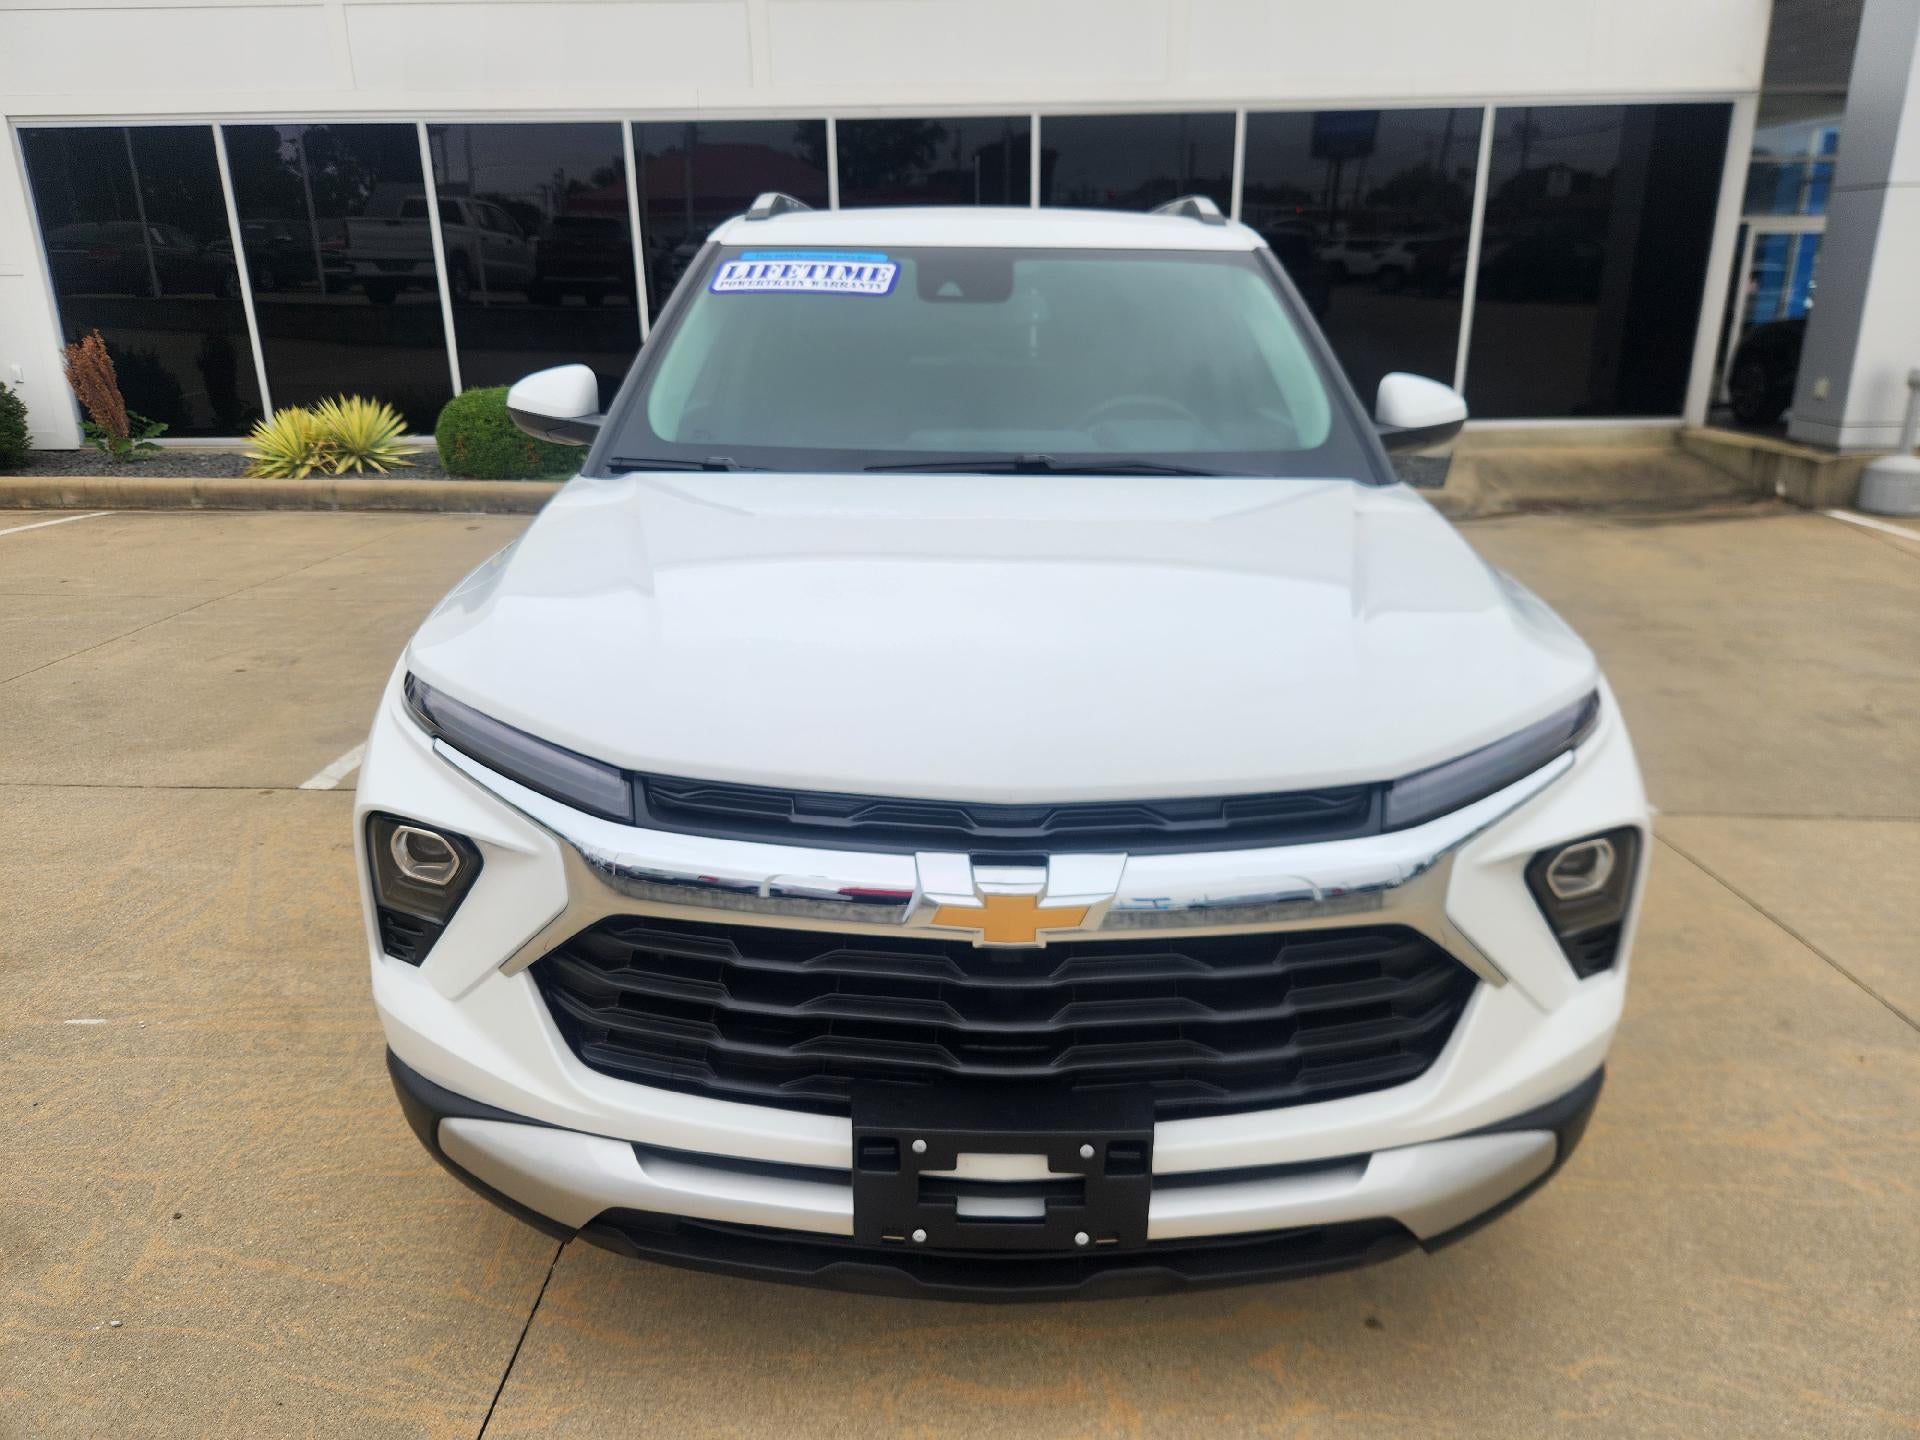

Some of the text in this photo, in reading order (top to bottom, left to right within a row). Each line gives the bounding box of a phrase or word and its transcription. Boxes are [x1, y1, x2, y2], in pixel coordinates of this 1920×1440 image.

[722, 263, 891, 282] LIFETIME
[719, 280, 883, 290] POWERTRAIN WARRANTY
